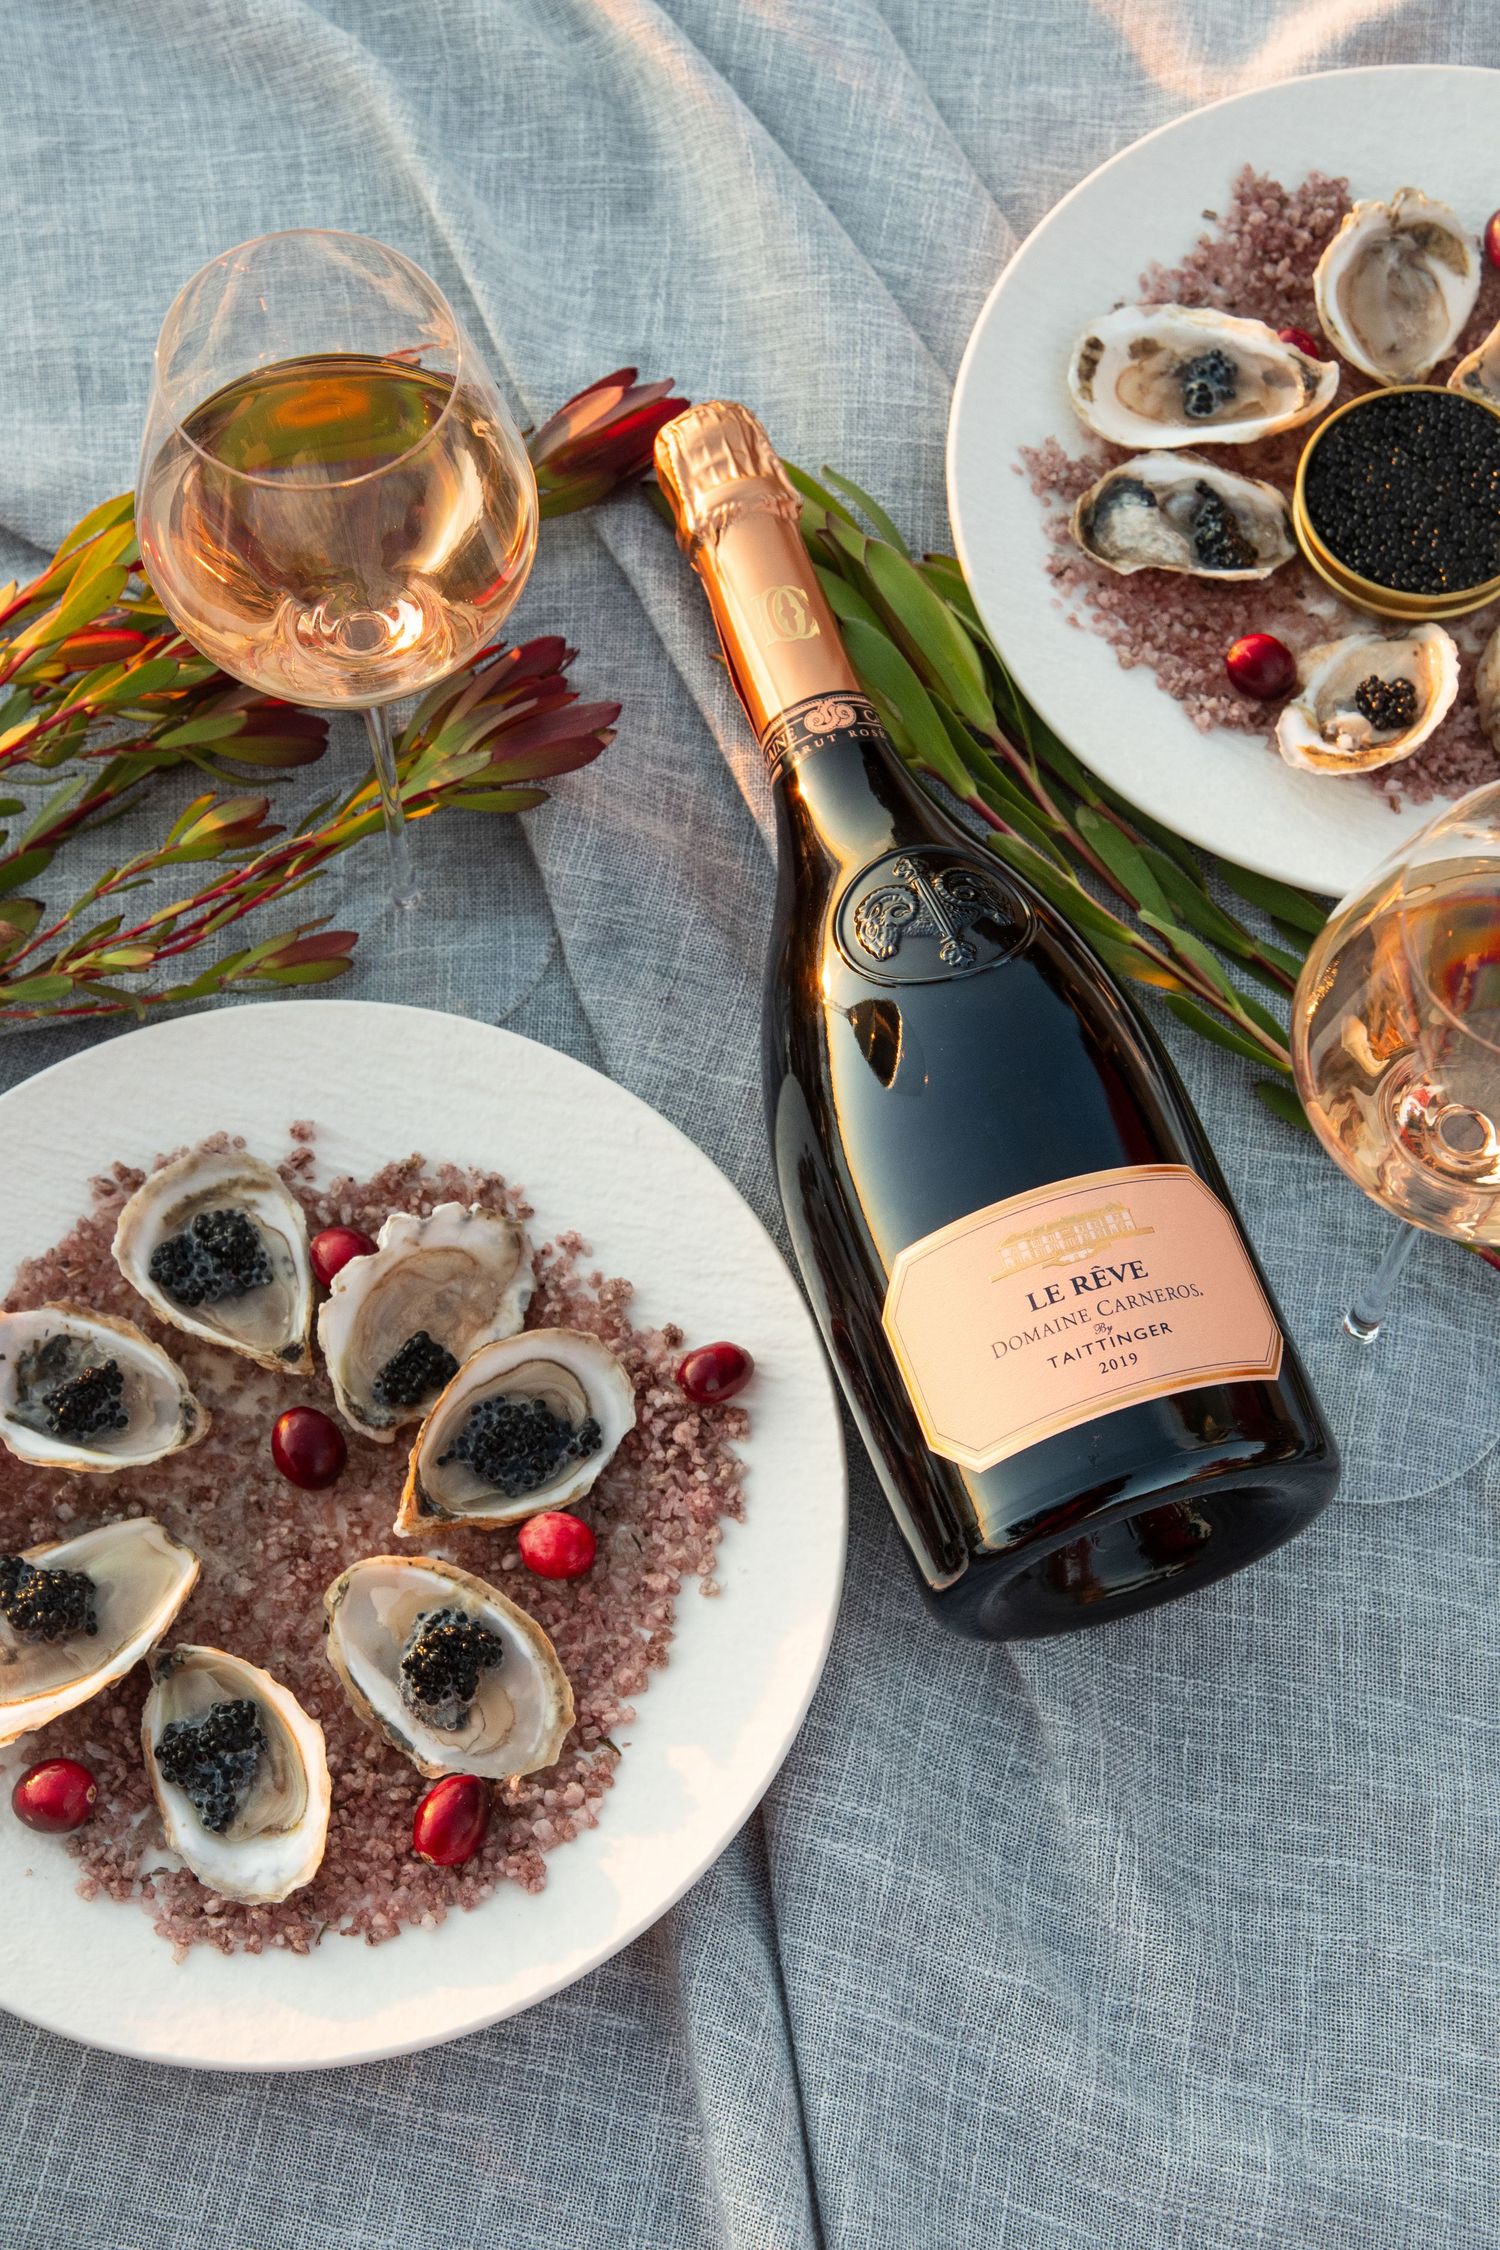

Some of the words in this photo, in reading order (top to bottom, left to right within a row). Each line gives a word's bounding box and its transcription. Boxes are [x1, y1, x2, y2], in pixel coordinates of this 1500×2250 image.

[792, 734, 837, 760] BRUT
[1026, 1283, 1066, 1312] LE
[1070, 1260, 1149, 1297] RÊVE
[990, 1308, 1092, 1360] DOMAINE
[1046, 1321, 1173, 1369] TAITTINGER
[1098, 1352, 1139, 1375] 2019
